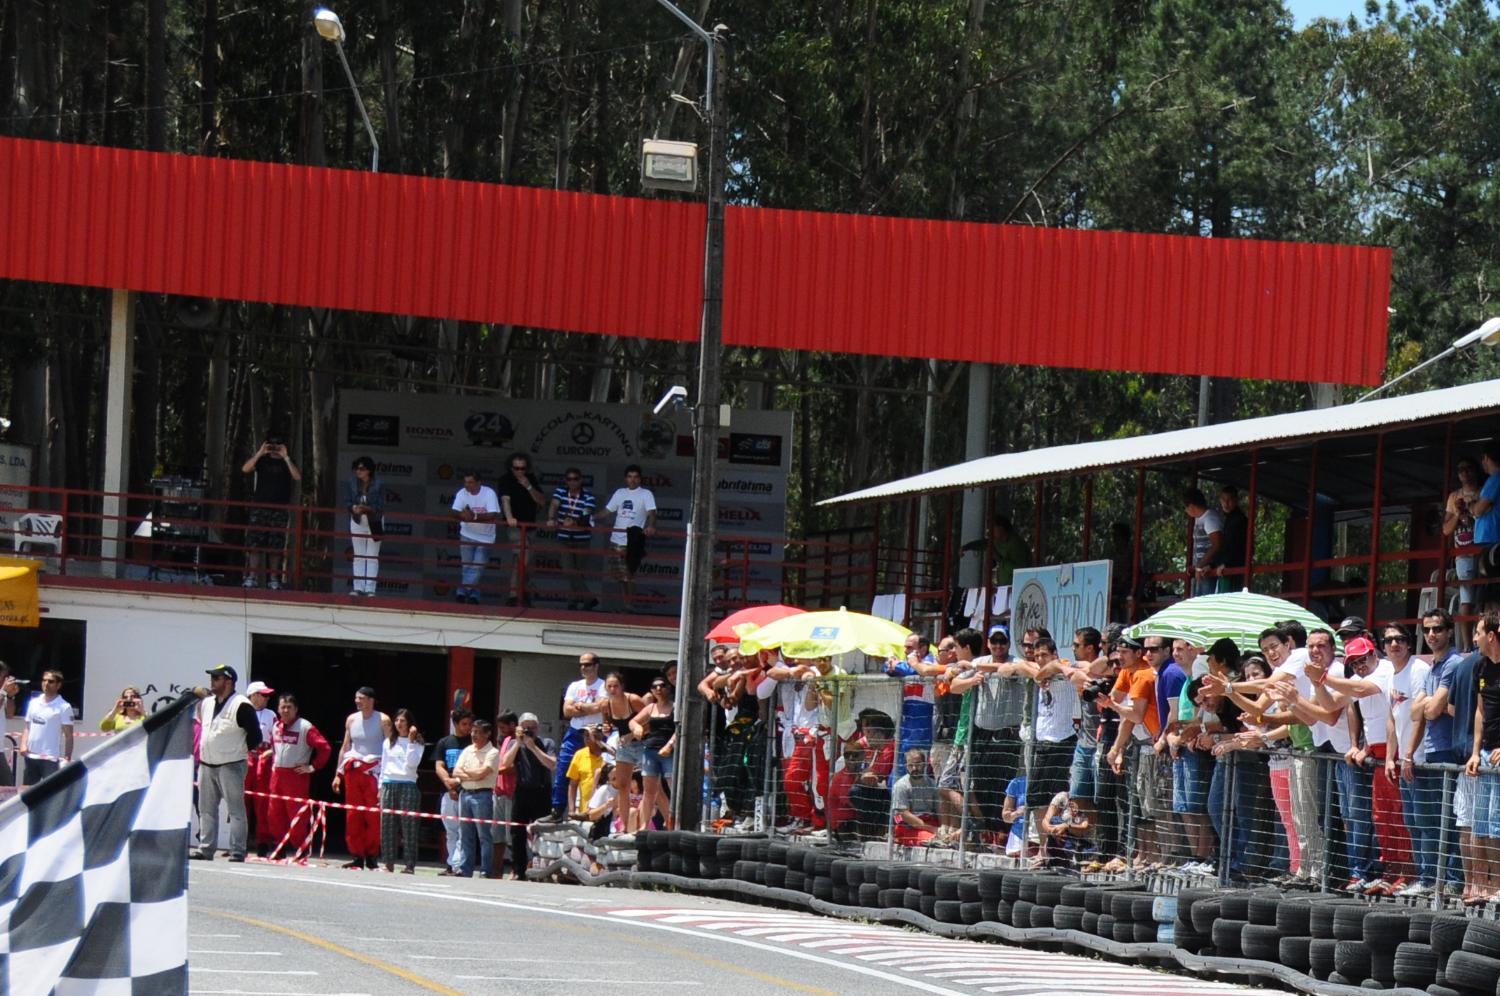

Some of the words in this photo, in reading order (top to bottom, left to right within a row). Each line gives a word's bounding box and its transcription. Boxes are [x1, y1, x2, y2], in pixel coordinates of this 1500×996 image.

[405, 425, 454, 437] HONDA
[530, 411, 575, 453] ESCOLA
[583, 410, 634, 457] KARTING
[556, 446, 612, 457] EUROINDY
